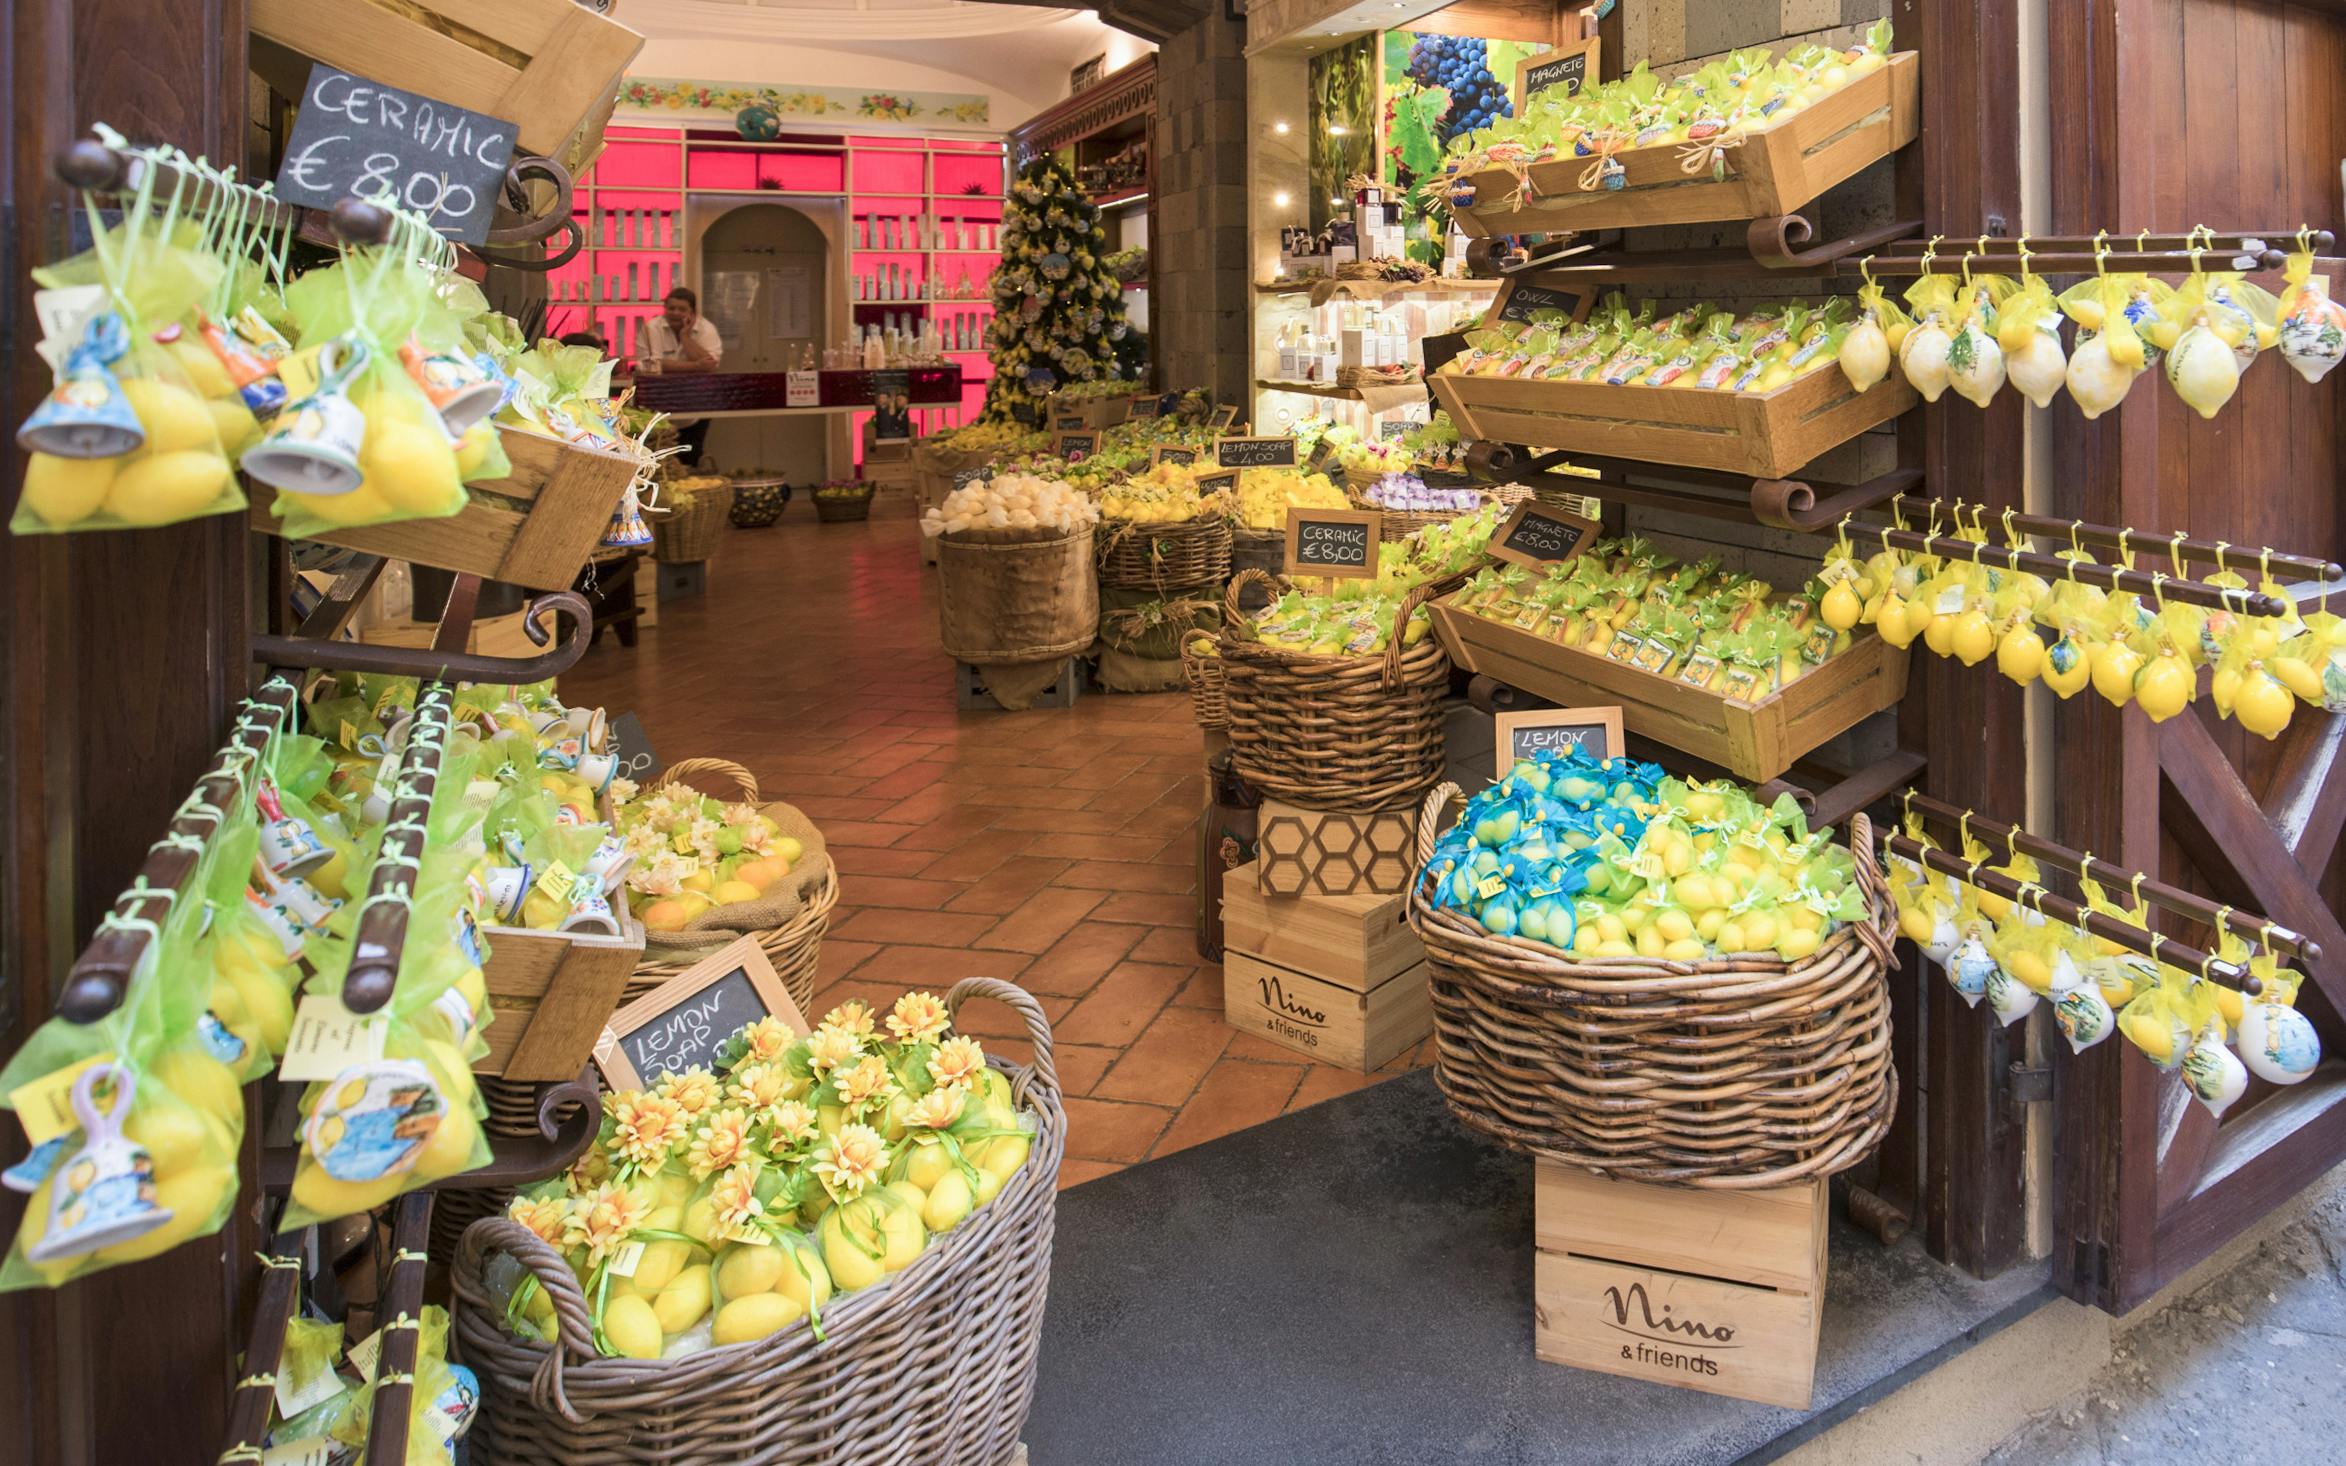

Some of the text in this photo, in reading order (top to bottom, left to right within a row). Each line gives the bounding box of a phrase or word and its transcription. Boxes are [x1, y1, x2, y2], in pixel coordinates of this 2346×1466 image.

[312, 74, 506, 170] CERAMIC
[1515, 289, 1555, 305] OWL
[1220, 441, 1292, 453] LEMON SOAP
[1520, 729, 1588, 747] LEMON
[1257, 975, 1326, 1023] Nino
[636, 989, 723, 1065] LEMON
[644, 1025, 711, 1083] SOAP
[1603, 1281, 1735, 1342] Nino
